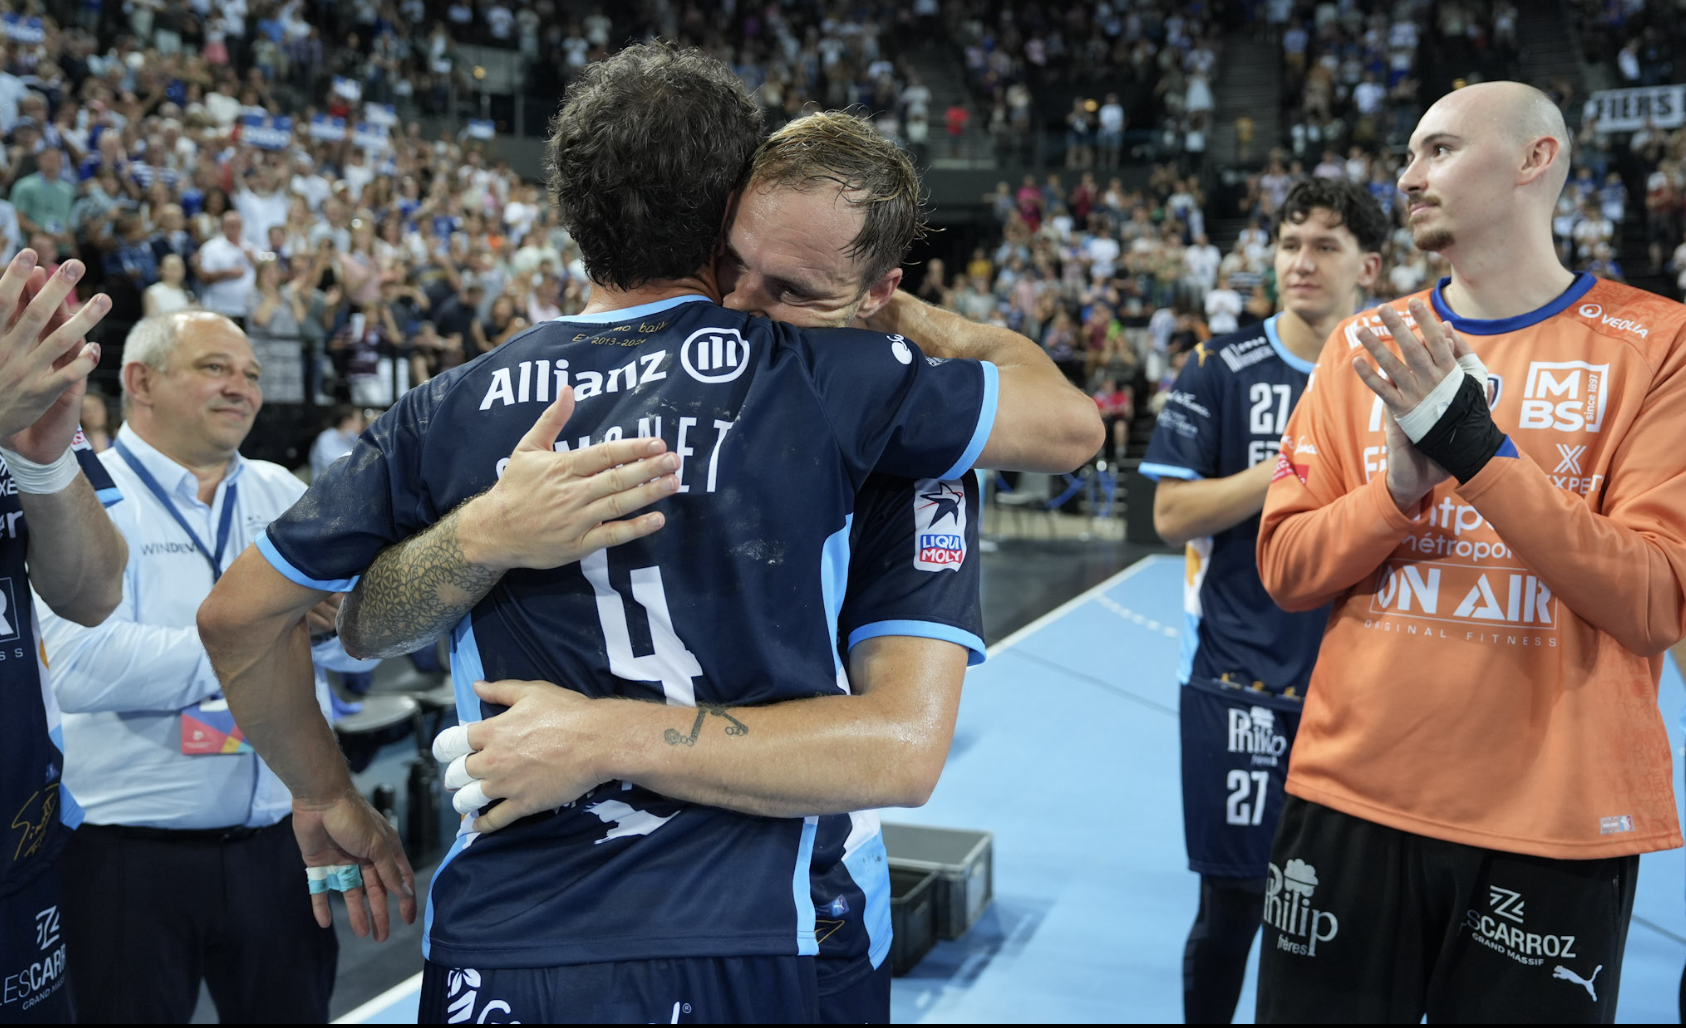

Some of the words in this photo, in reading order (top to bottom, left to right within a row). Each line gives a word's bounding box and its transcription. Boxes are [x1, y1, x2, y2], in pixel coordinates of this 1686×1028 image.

[1601, 314, 1649, 339] VEOLIA
[479, 349, 667, 411] Allianz
[1249, 383, 1292, 434] 27
[921, 549, 962, 562] MOLY
[922, 535, 961, 550] LIQUI
[1378, 564, 1441, 614] ON
[1453, 573, 1552, 623] AIR
[581, 547, 703, 704] 4
[1466, 632, 1556, 647] FITNESS
[1227, 769, 1269, 825] 27
[1264, 862, 1339, 957] Philip
[1277, 934, 1308, 955] frères
[1459, 908, 1576, 958] SCARROZ
[1472, 932, 1505, 955] GRAND
[1507, 949, 1545, 966] MASSIF
[22, 988, 51, 1010] GRAND
